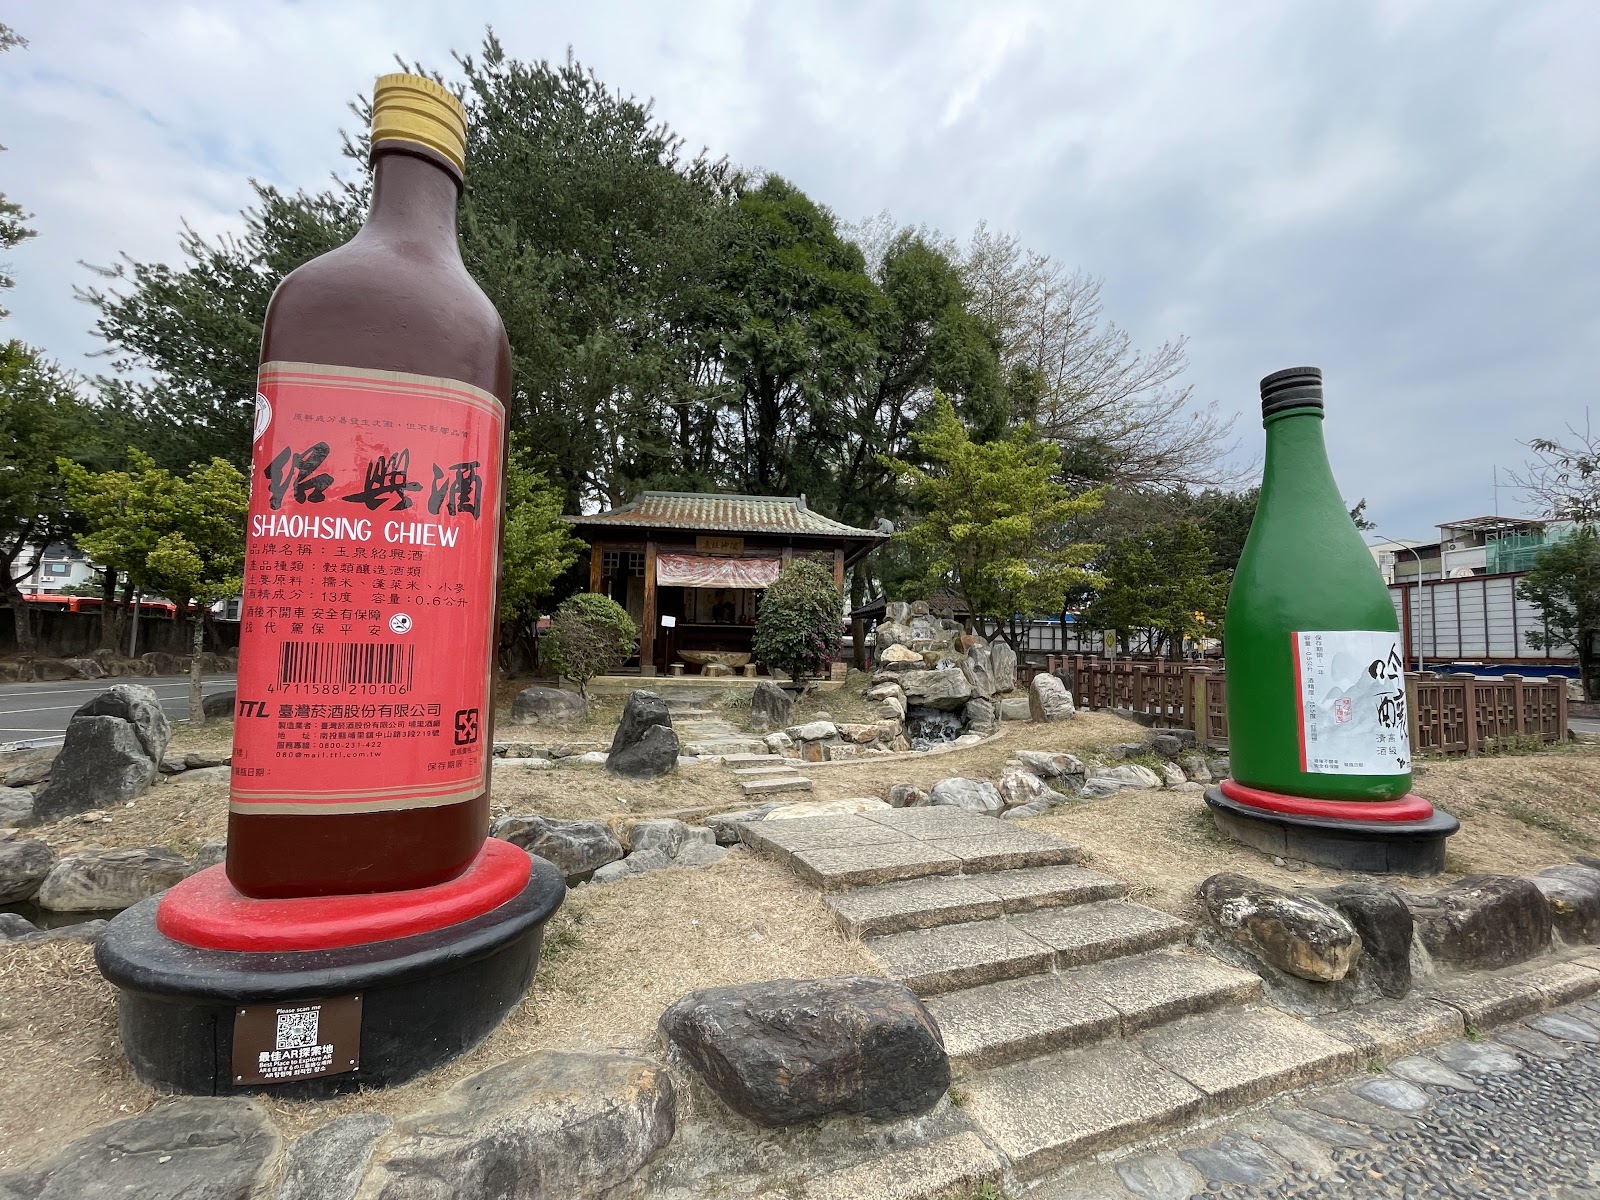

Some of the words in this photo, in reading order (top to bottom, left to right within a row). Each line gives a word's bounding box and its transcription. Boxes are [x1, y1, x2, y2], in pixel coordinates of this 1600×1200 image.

[264, 441, 482, 520] 紹興酒
[252, 514, 371, 541] SHAOHSING
[384, 520, 460, 547] CHIEW
[311, 608, 382, 622] 安全有保障
[267, 683, 275, 694] 4
[282, 683, 340, 695] 711588
[348, 684, 407, 695] 210106
[239, 700, 271, 718] TTL
[278, 703, 441, 719] 臺灣菸酒股份有限公司
[299, 1056, 322, 1064] Explore
